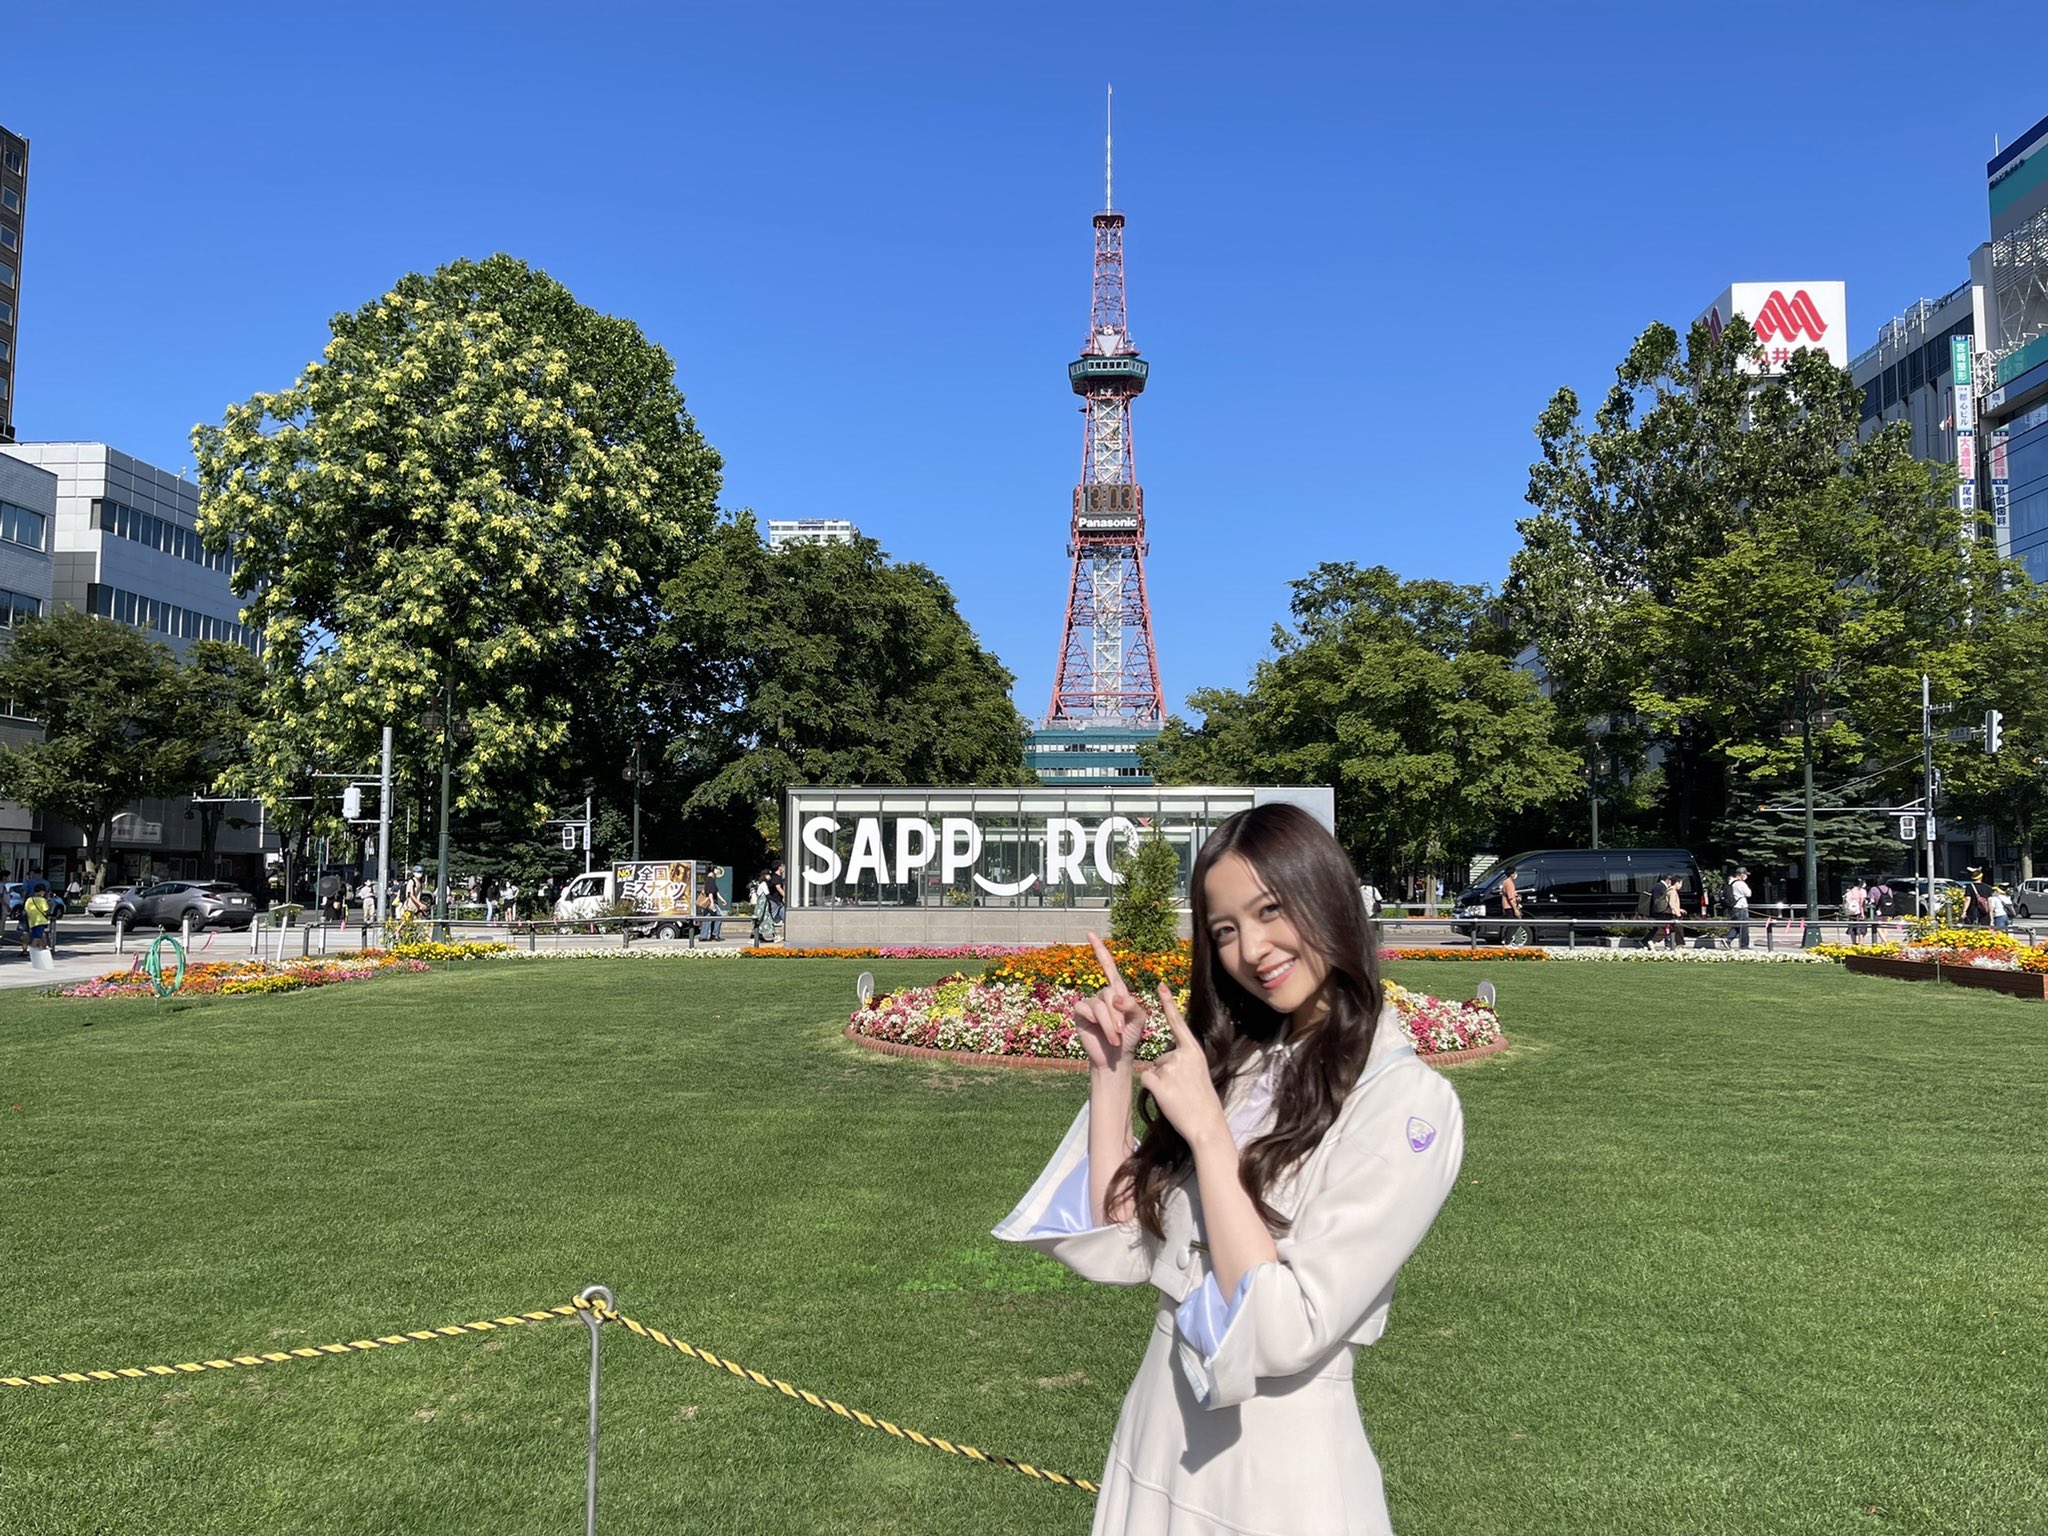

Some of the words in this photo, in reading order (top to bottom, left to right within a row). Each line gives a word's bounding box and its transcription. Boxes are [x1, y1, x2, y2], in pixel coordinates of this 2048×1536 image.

[1959, 393, 1969, 426] 都心ビル
[1078, 517, 1137, 528] Panasonic
[639, 866, 668, 882] 全国
[622, 881, 686, 899] ミスナイツ
